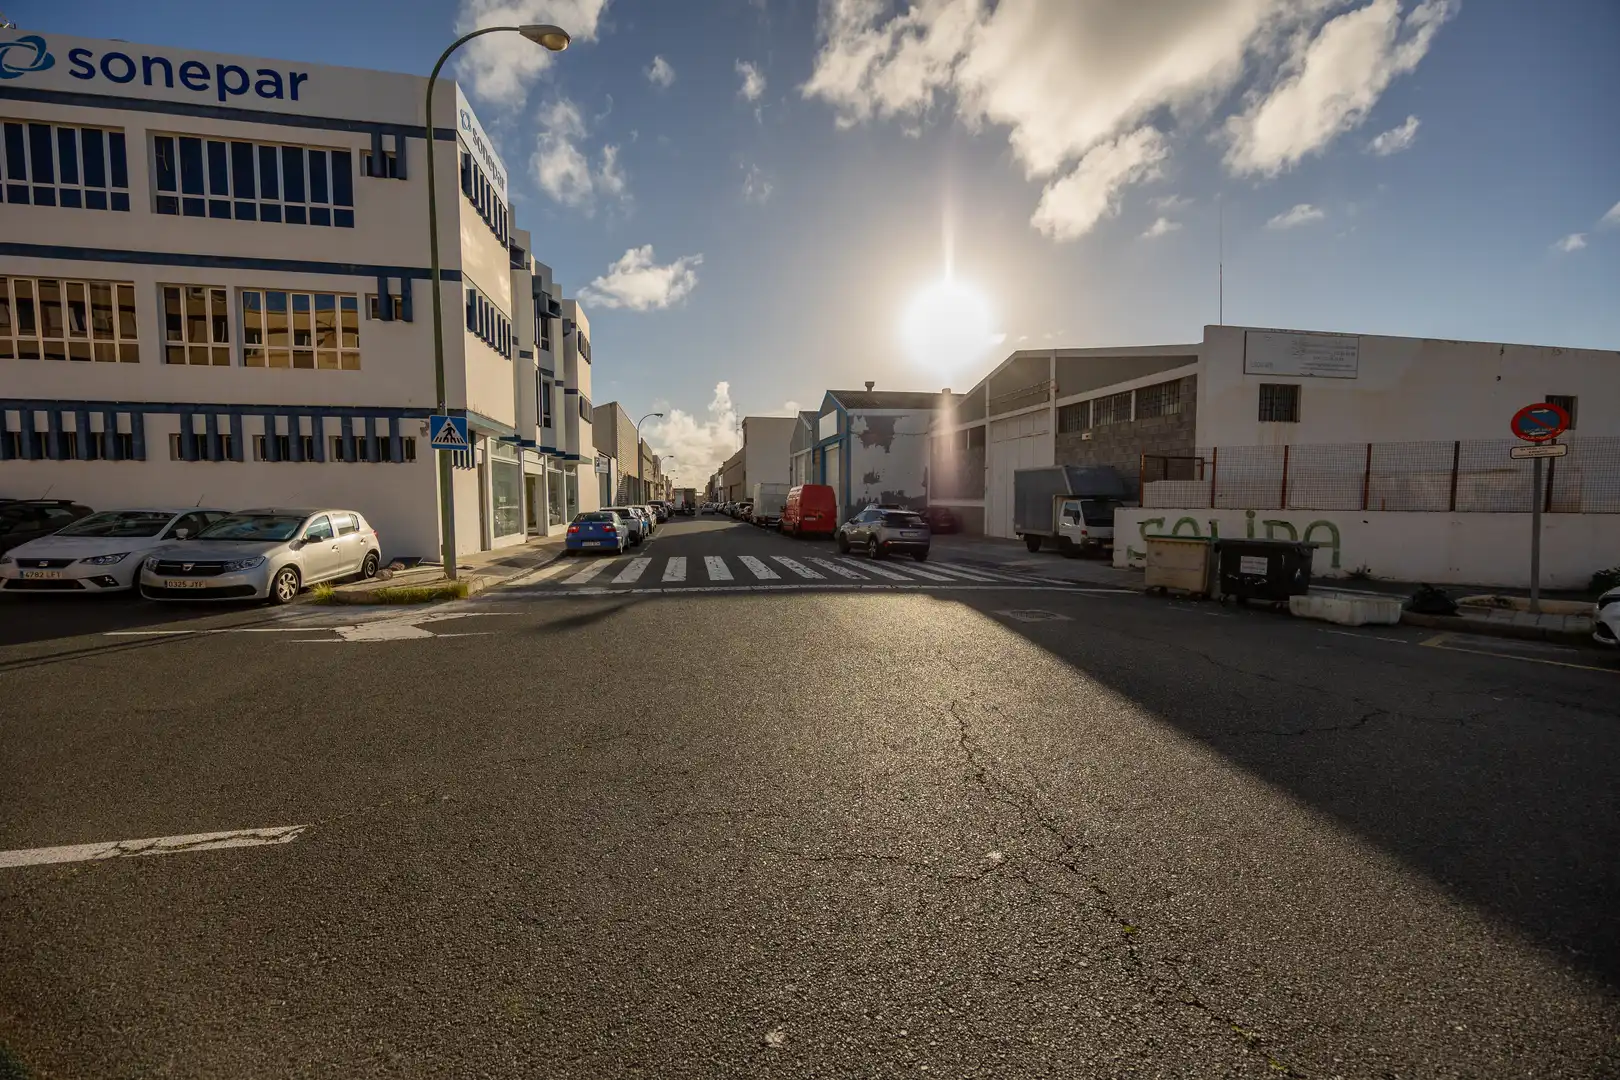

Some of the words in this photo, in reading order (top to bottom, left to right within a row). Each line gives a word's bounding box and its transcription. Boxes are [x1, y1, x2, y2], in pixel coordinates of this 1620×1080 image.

[68, 47, 308, 101] sonepar
[472, 127, 505, 192] sonepar
[168, 580, 187, 588] 0325
